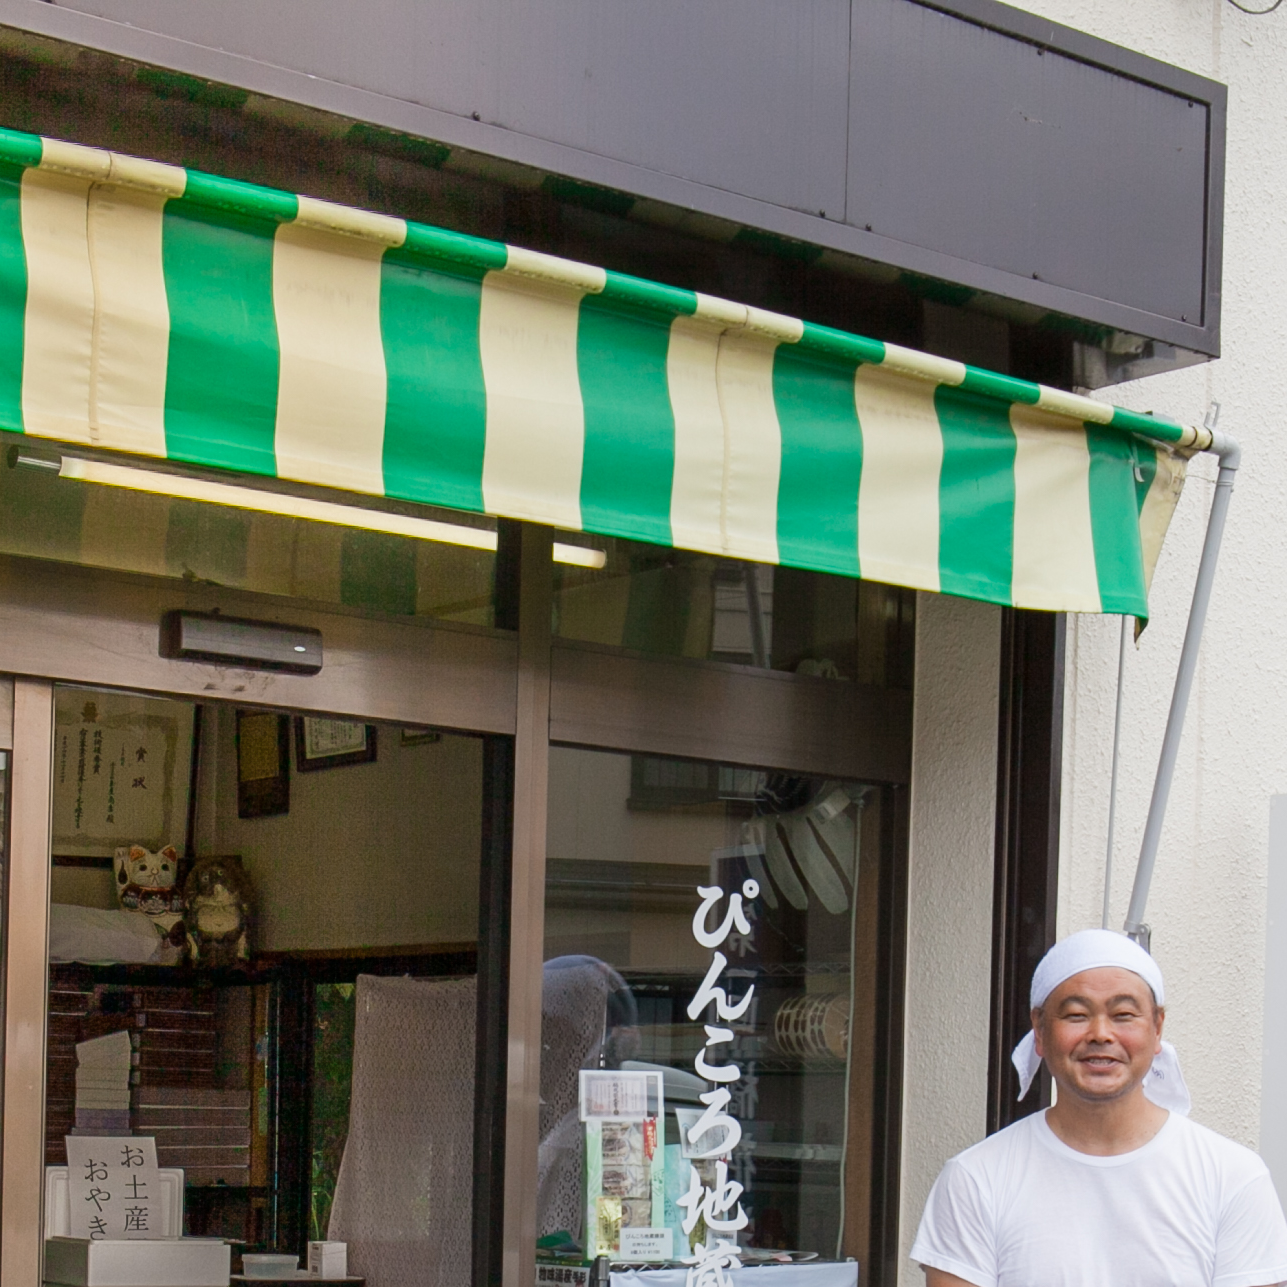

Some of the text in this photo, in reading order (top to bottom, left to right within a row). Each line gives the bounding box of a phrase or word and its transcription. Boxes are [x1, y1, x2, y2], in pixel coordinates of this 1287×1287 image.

[84, 1159, 111, 1240] おやき
[120, 1145, 149, 1240] お土産
